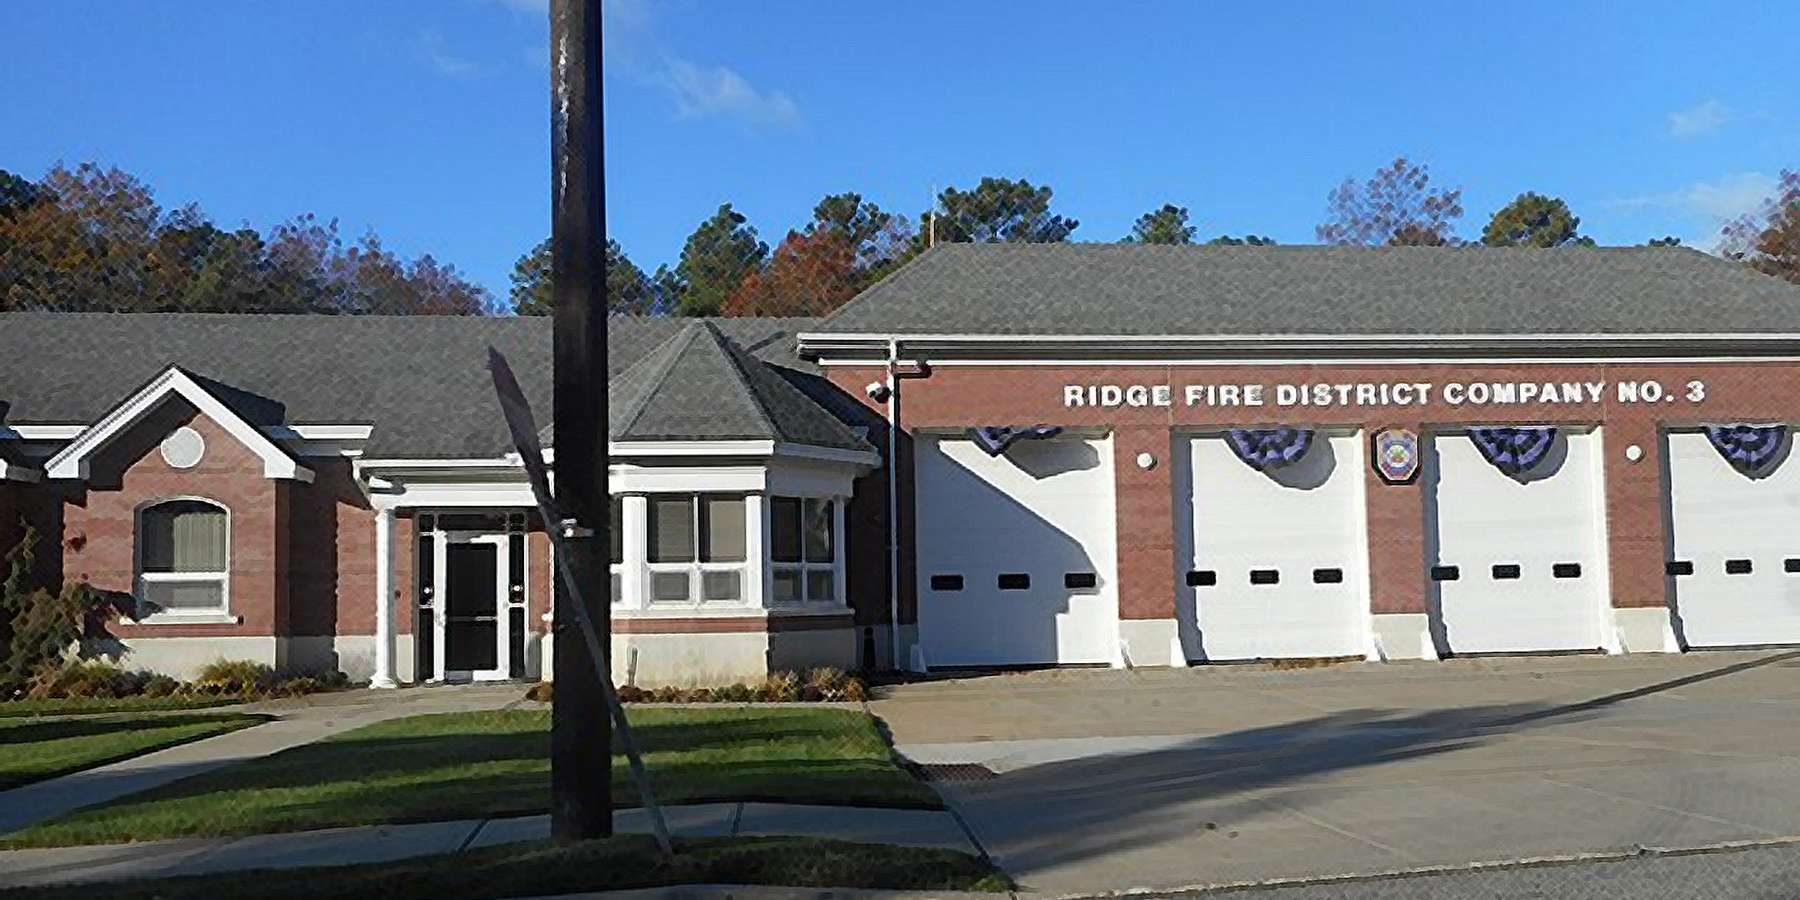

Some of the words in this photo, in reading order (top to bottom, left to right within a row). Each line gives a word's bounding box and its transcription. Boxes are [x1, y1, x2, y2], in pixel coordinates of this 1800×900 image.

[1063, 384, 1172, 407] RIDGE
[1184, 384, 1264, 406] FIRE
[1276, 382, 1432, 406] DISTRICT
[1443, 381, 1605, 405] COMPANY
[1617, 380, 1674, 403] NO.
[1685, 380, 1705, 402] 3
